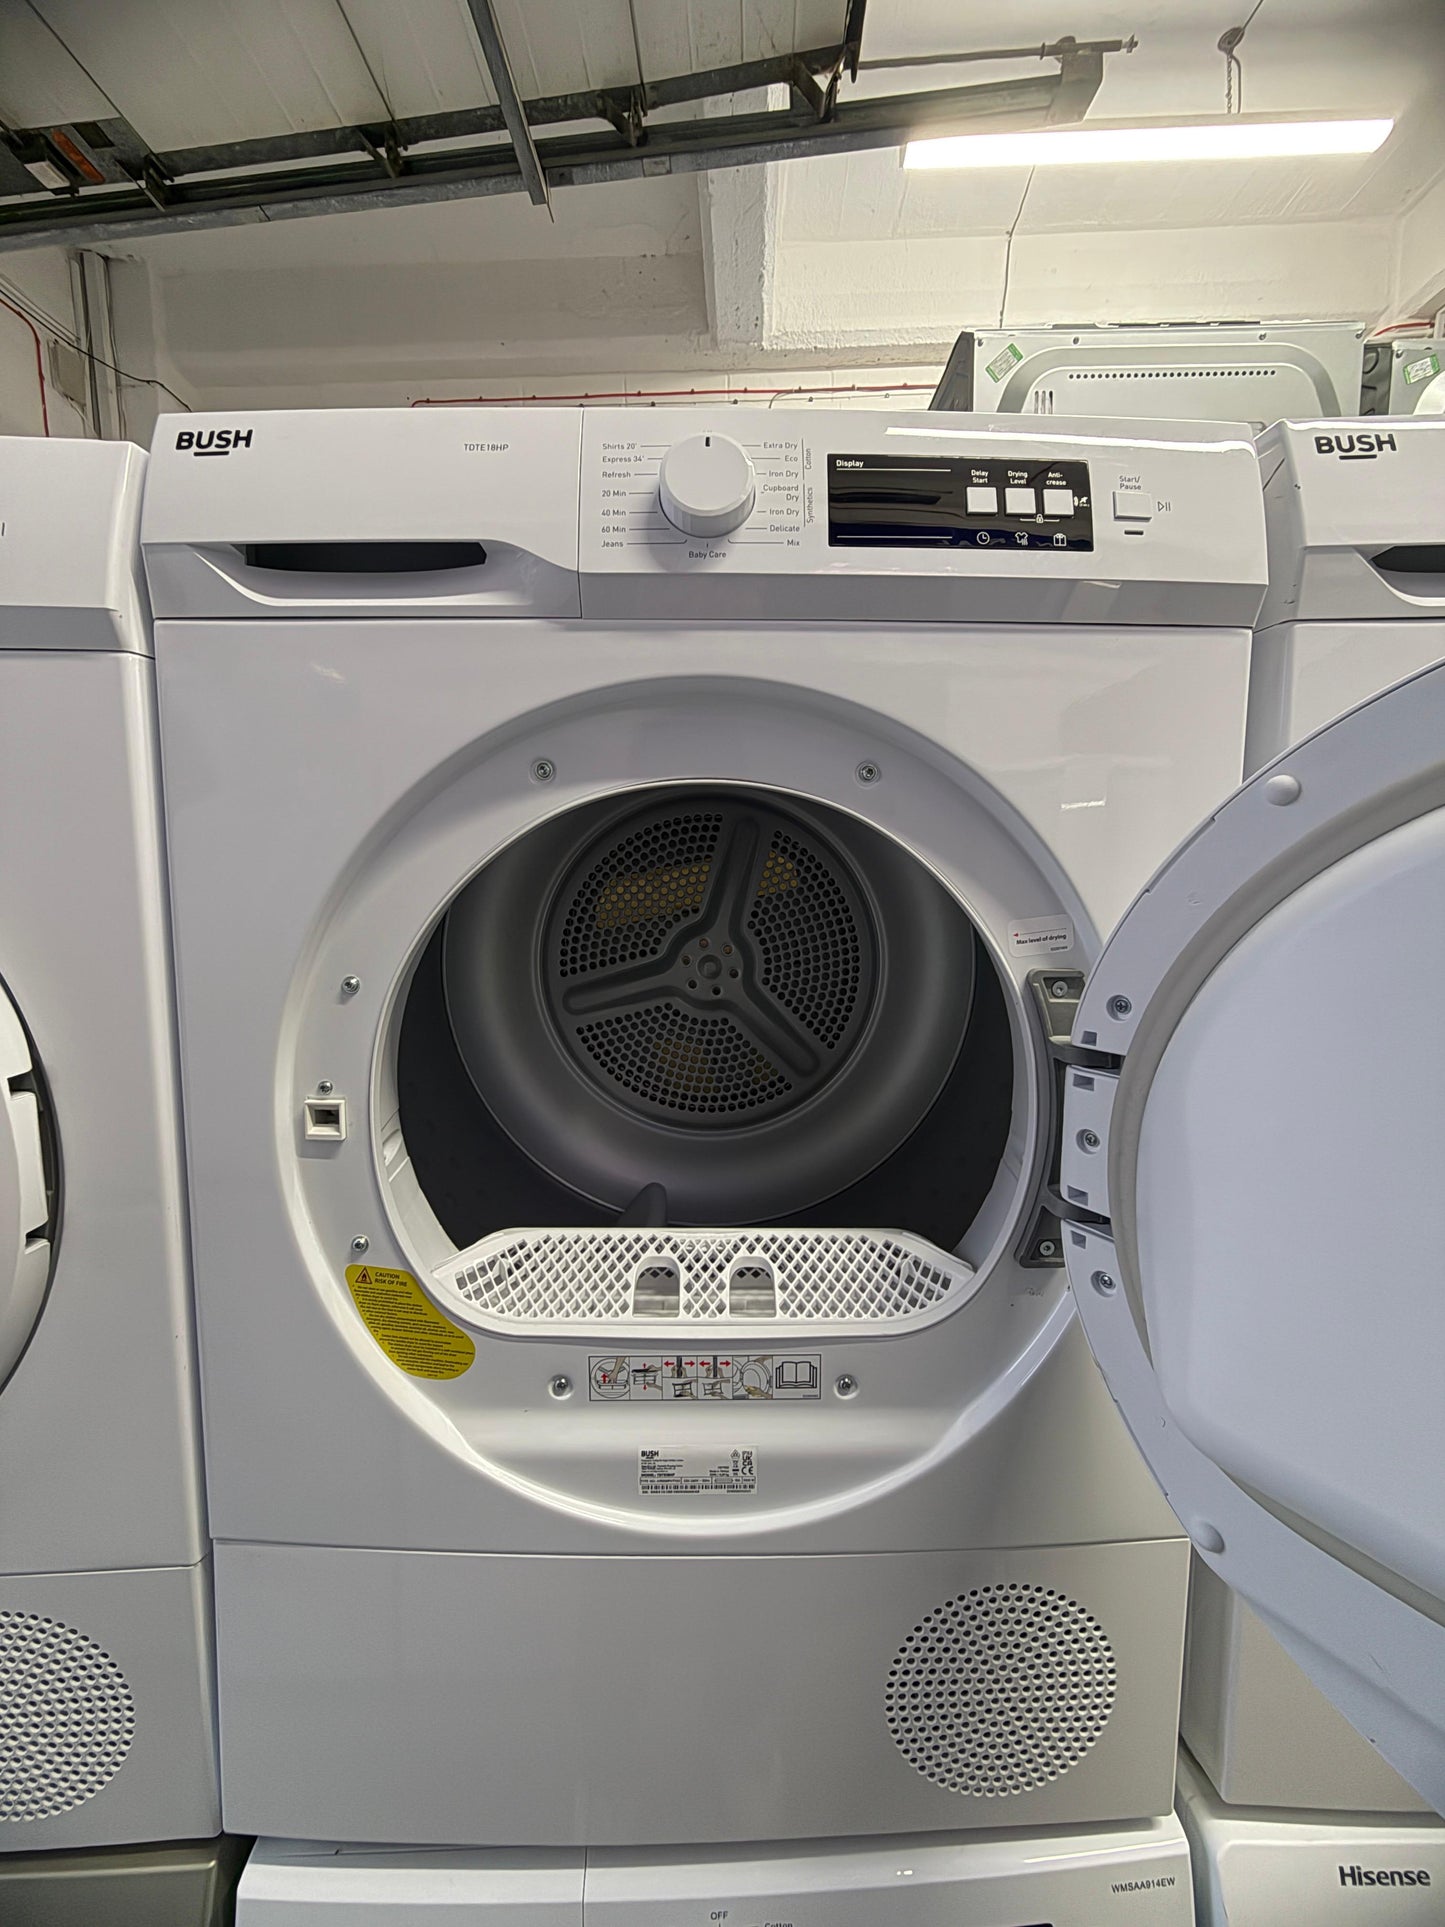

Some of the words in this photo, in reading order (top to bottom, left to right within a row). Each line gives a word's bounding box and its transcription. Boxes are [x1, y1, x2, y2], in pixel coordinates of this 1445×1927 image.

[175, 429, 253, 450] BUSH
[1314, 433, 1398, 454] BUSH
[463, 443, 510, 452] TDTE18HP
[784, 442, 798, 451] Dry
[836, 460, 864, 468] Display
[785, 471, 799, 479] Dry
[971, 469, 989, 477] Delay
[1008, 470, 1028, 479] Drying
[1119, 475, 1140, 484] Start/
[763, 484, 799, 493] Cupboard
[1119, 482, 1142, 491] Pause
[786, 494, 800, 502] Dry
[807, 487, 815, 523] Synthetics
[786, 508, 800, 517] Dry
[688, 551, 707, 559] Baby
[1049, 933, 1067, 941] drying
[375, 1272, 400, 1280] CAUTION
[396, 1280, 408, 1288] FIRE
[1338, 1865, 1431, 1887] Hisense
[1111, 1877, 1176, 1894] WMSAA914EW
[710, 1911, 728, 1920] OFF
